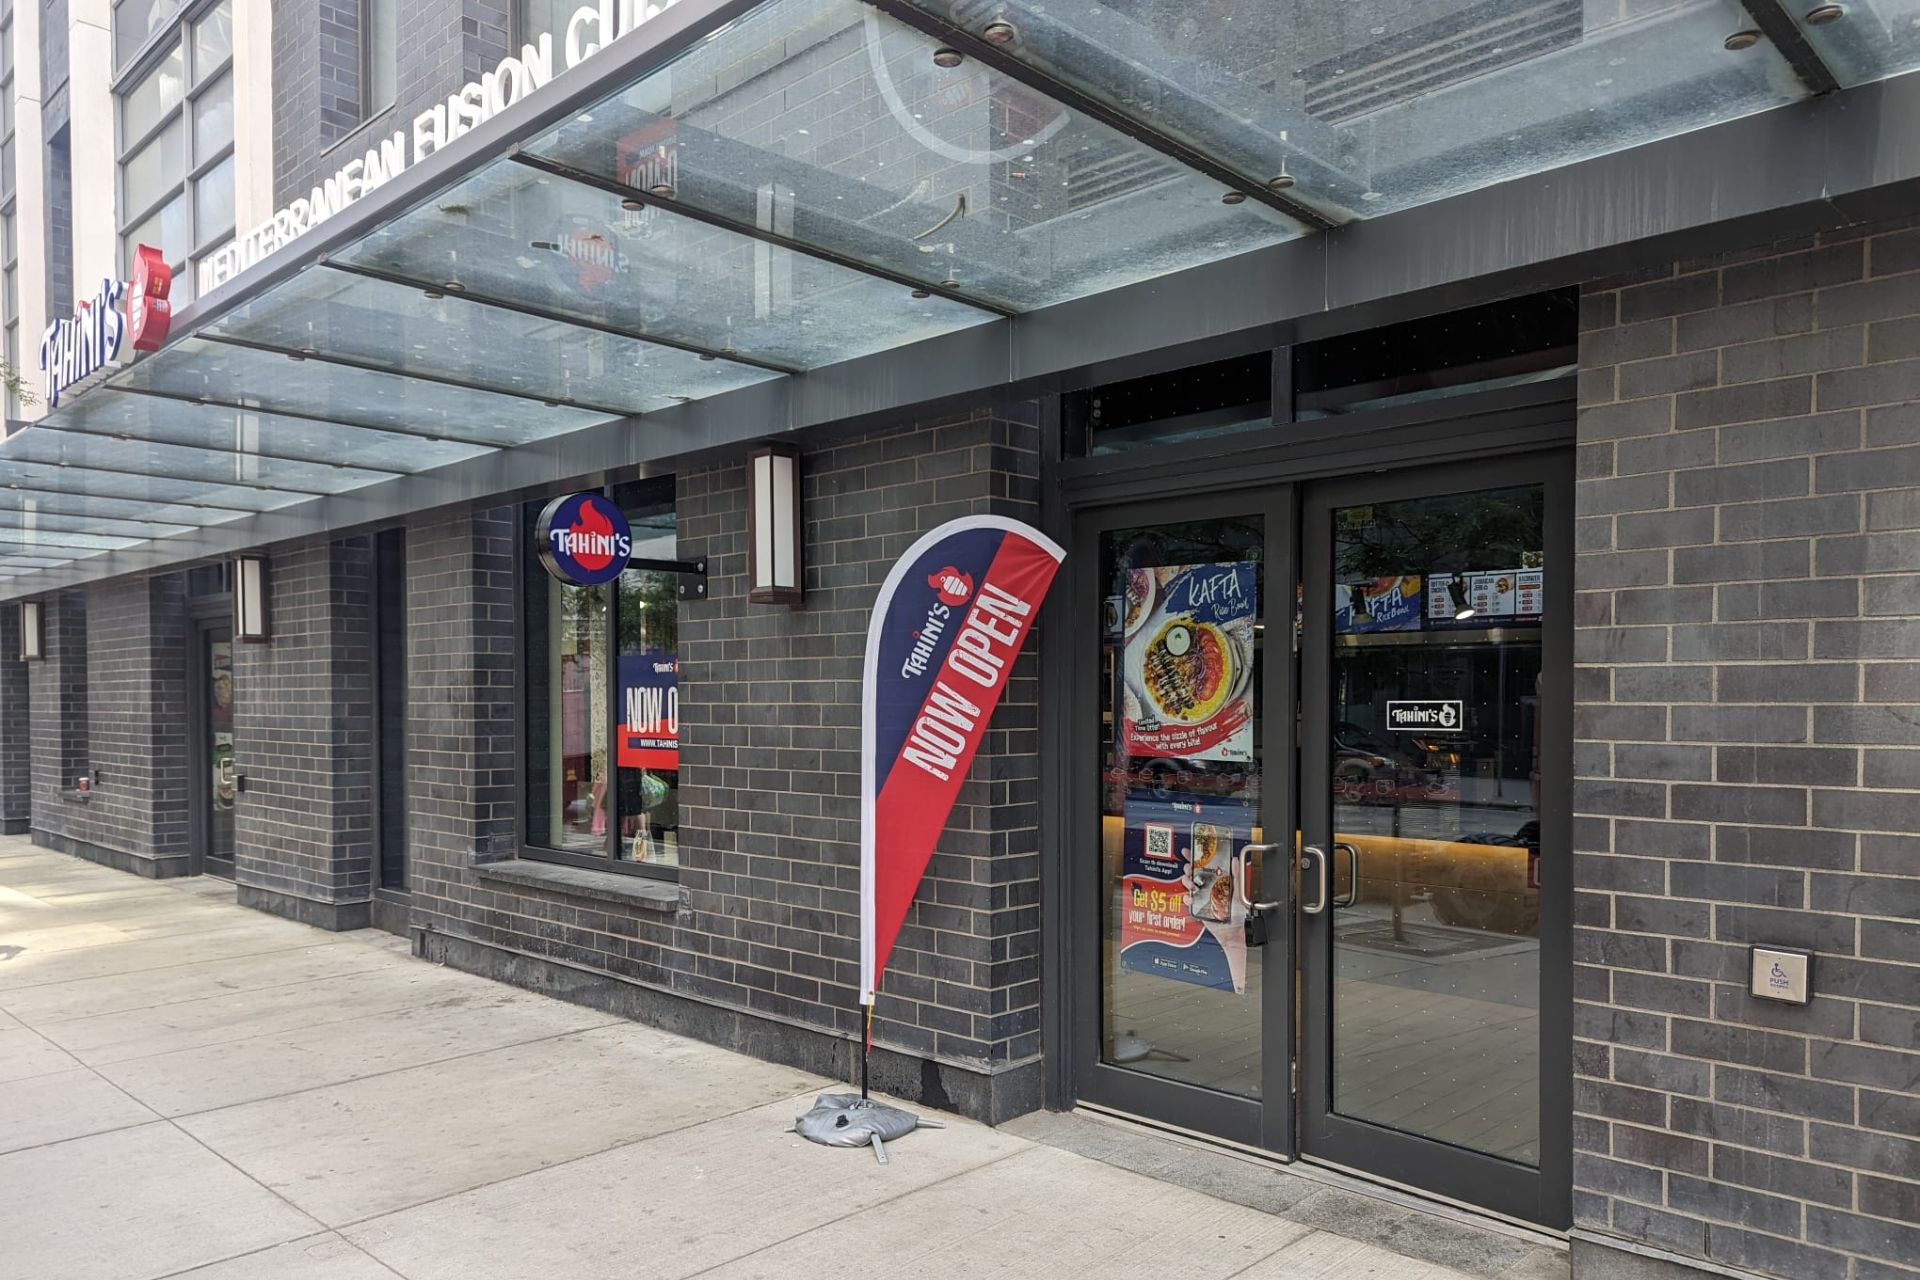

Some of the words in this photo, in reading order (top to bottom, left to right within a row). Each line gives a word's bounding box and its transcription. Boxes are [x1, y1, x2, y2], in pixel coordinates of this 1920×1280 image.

[199, 131, 405, 298] MEDITERRANEAN
[413, 32, 553, 168] FUSION
[1188, 568, 1241, 606] KAFTA
[902, 681, 982, 782] NOW
[948, 582, 1032, 688] OPEN
[626, 686, 663, 734] NOW
[1130, 733, 1159, 742] Experience
[1160, 733, 1171, 741] the
[1172, 731, 1188, 740] sizzle
[1188, 729, 1196, 738] of
[1197, 722, 1218, 735] flavour
[1155, 742, 1169, 751] with
[1170, 740, 1187, 750] every
[1133, 889, 1148, 908] Get
[1150, 890, 1167, 912] $5
[1169, 895, 1182, 913] off
[1129, 910, 1145, 923] your
[1147, 911, 1161, 927] first
[1163, 915, 1186, 931] order!
